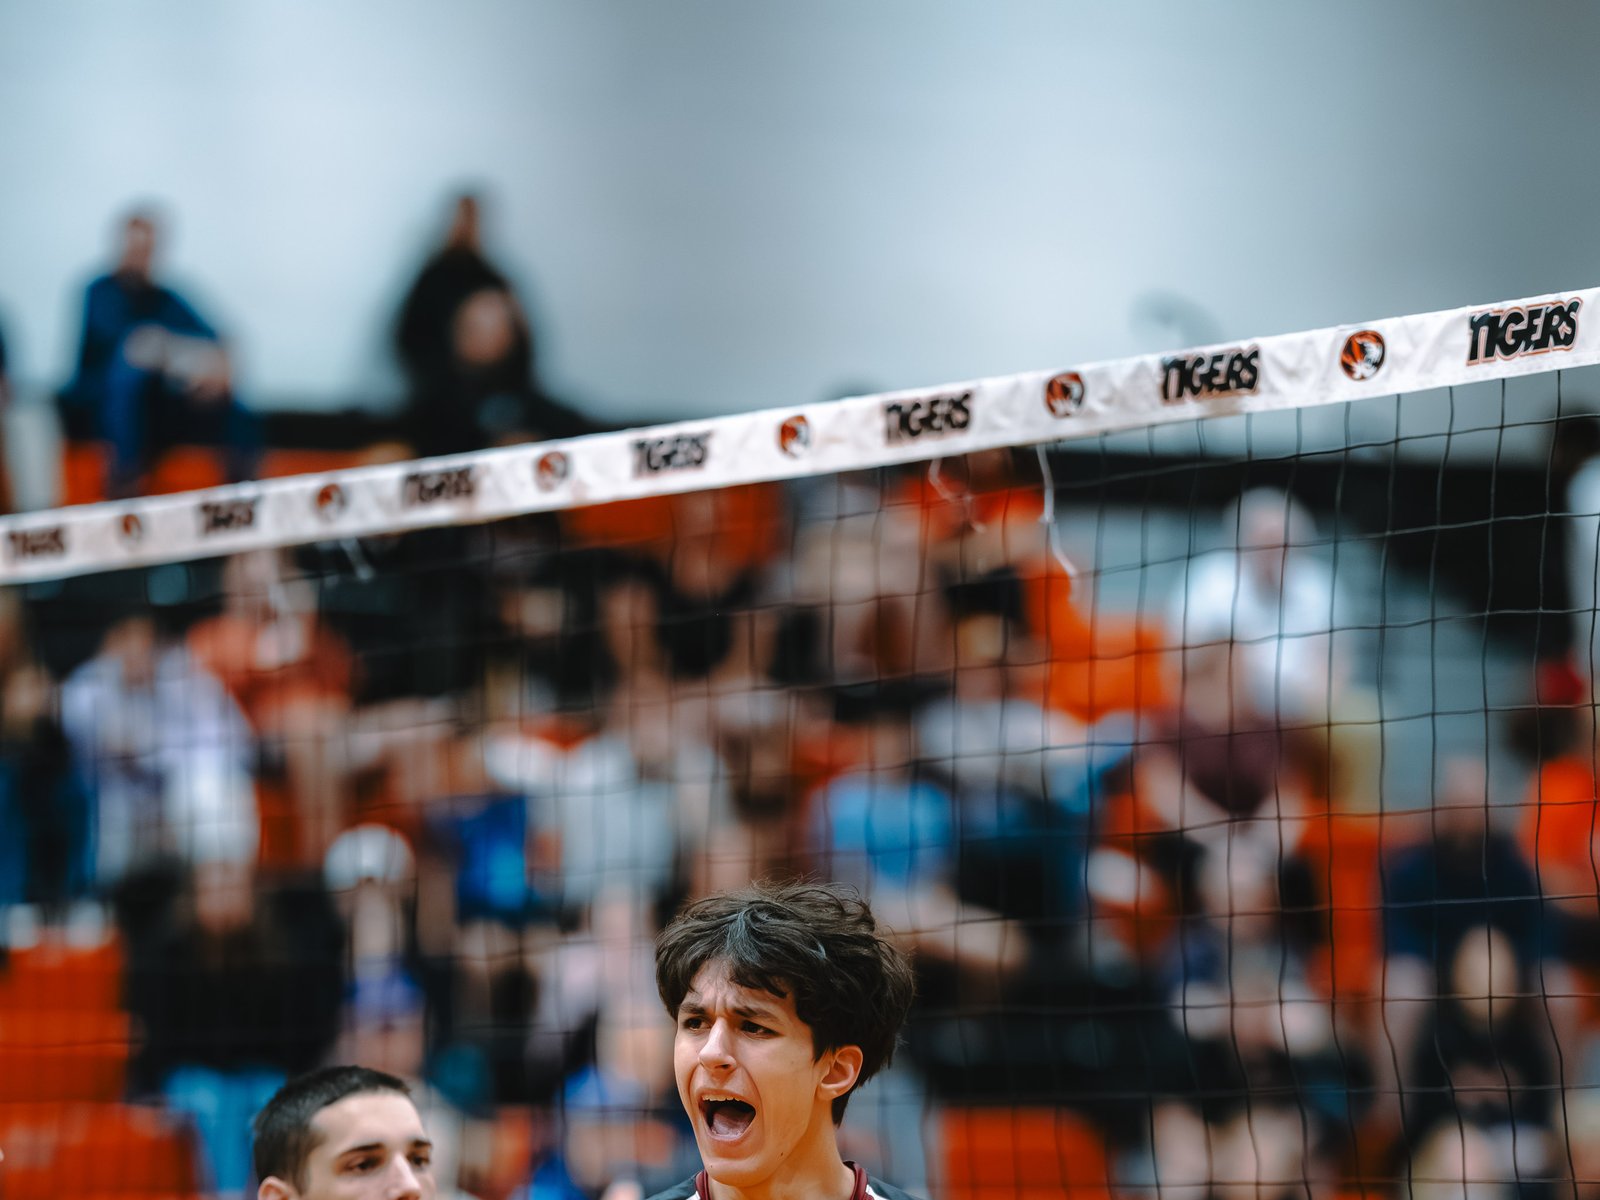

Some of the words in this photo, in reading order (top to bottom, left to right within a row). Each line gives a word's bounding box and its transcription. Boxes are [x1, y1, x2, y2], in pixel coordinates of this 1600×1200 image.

[1466, 297, 1583, 366] TIGERS
[1161, 345, 1260, 401] TIGERS
[883, 390, 973, 446] TIGERS
